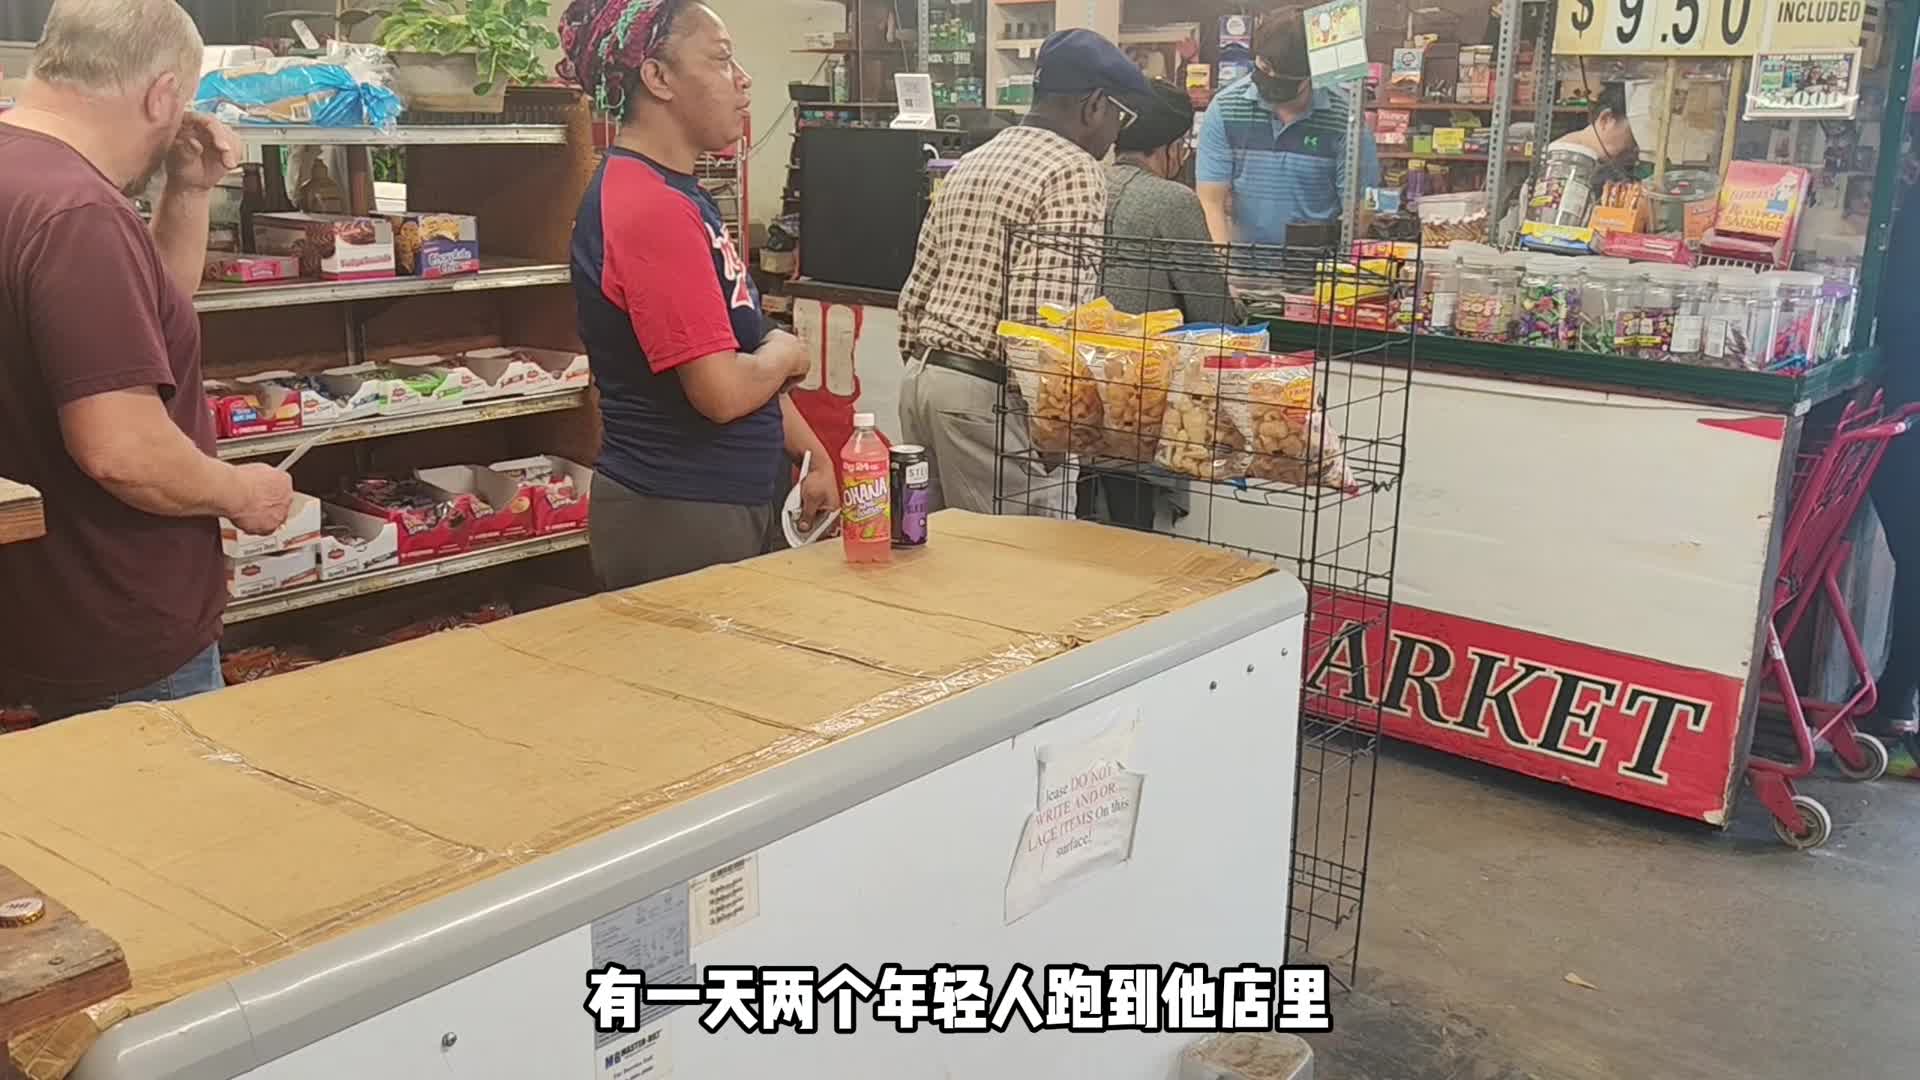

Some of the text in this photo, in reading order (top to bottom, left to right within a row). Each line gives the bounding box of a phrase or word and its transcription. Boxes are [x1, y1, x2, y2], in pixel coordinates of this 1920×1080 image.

[1777, 1, 1861, 23] INCLUDED
[843, 476, 888, 507] OHANA
[1304, 620, 1712, 785] ARKET
[1047, 764, 1113, 803] lease DO NOT
[1035, 800, 1071, 825] WRITE
[1028, 827, 1058, 852] LACE
[1059, 809, 1094, 836] ITEMS
